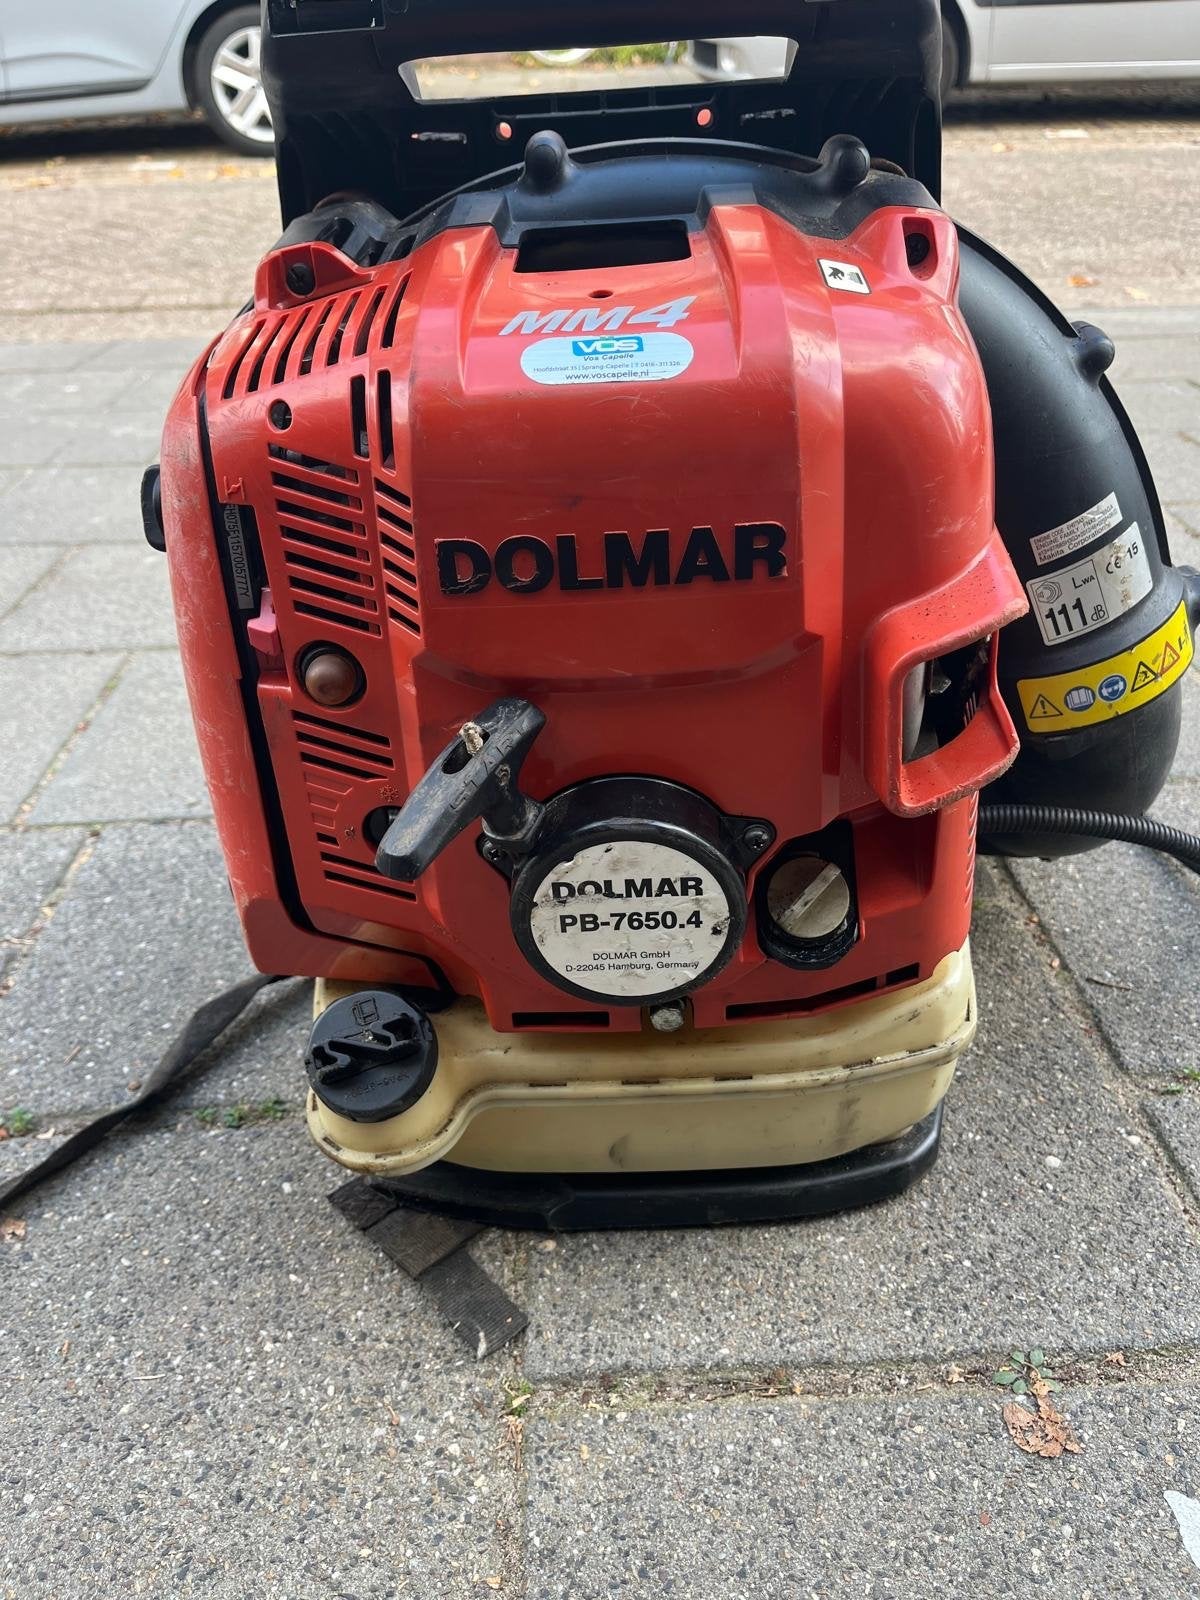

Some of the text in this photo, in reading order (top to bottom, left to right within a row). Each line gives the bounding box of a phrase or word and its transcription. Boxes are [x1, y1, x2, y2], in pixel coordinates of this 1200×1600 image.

[498, 295, 698, 336] MM4
[577, 339, 639, 353] VOS
[565, 369, 649, 379] www.voscapelle.nl
[1039, 525, 1105, 562] Makita Corporation
[1126, 542, 1139, 559] 15
[434, 520, 789, 595] DOLMAR
[1045, 597, 1106, 636] 111 dB
[551, 876, 704, 903] DOLMAR
[559, 910, 703, 933] PB-7650.4
[565, 961, 699, 972] D-22045 Hamburg, Germany
[592, 951, 671, 961] DOLMAR GmbH
